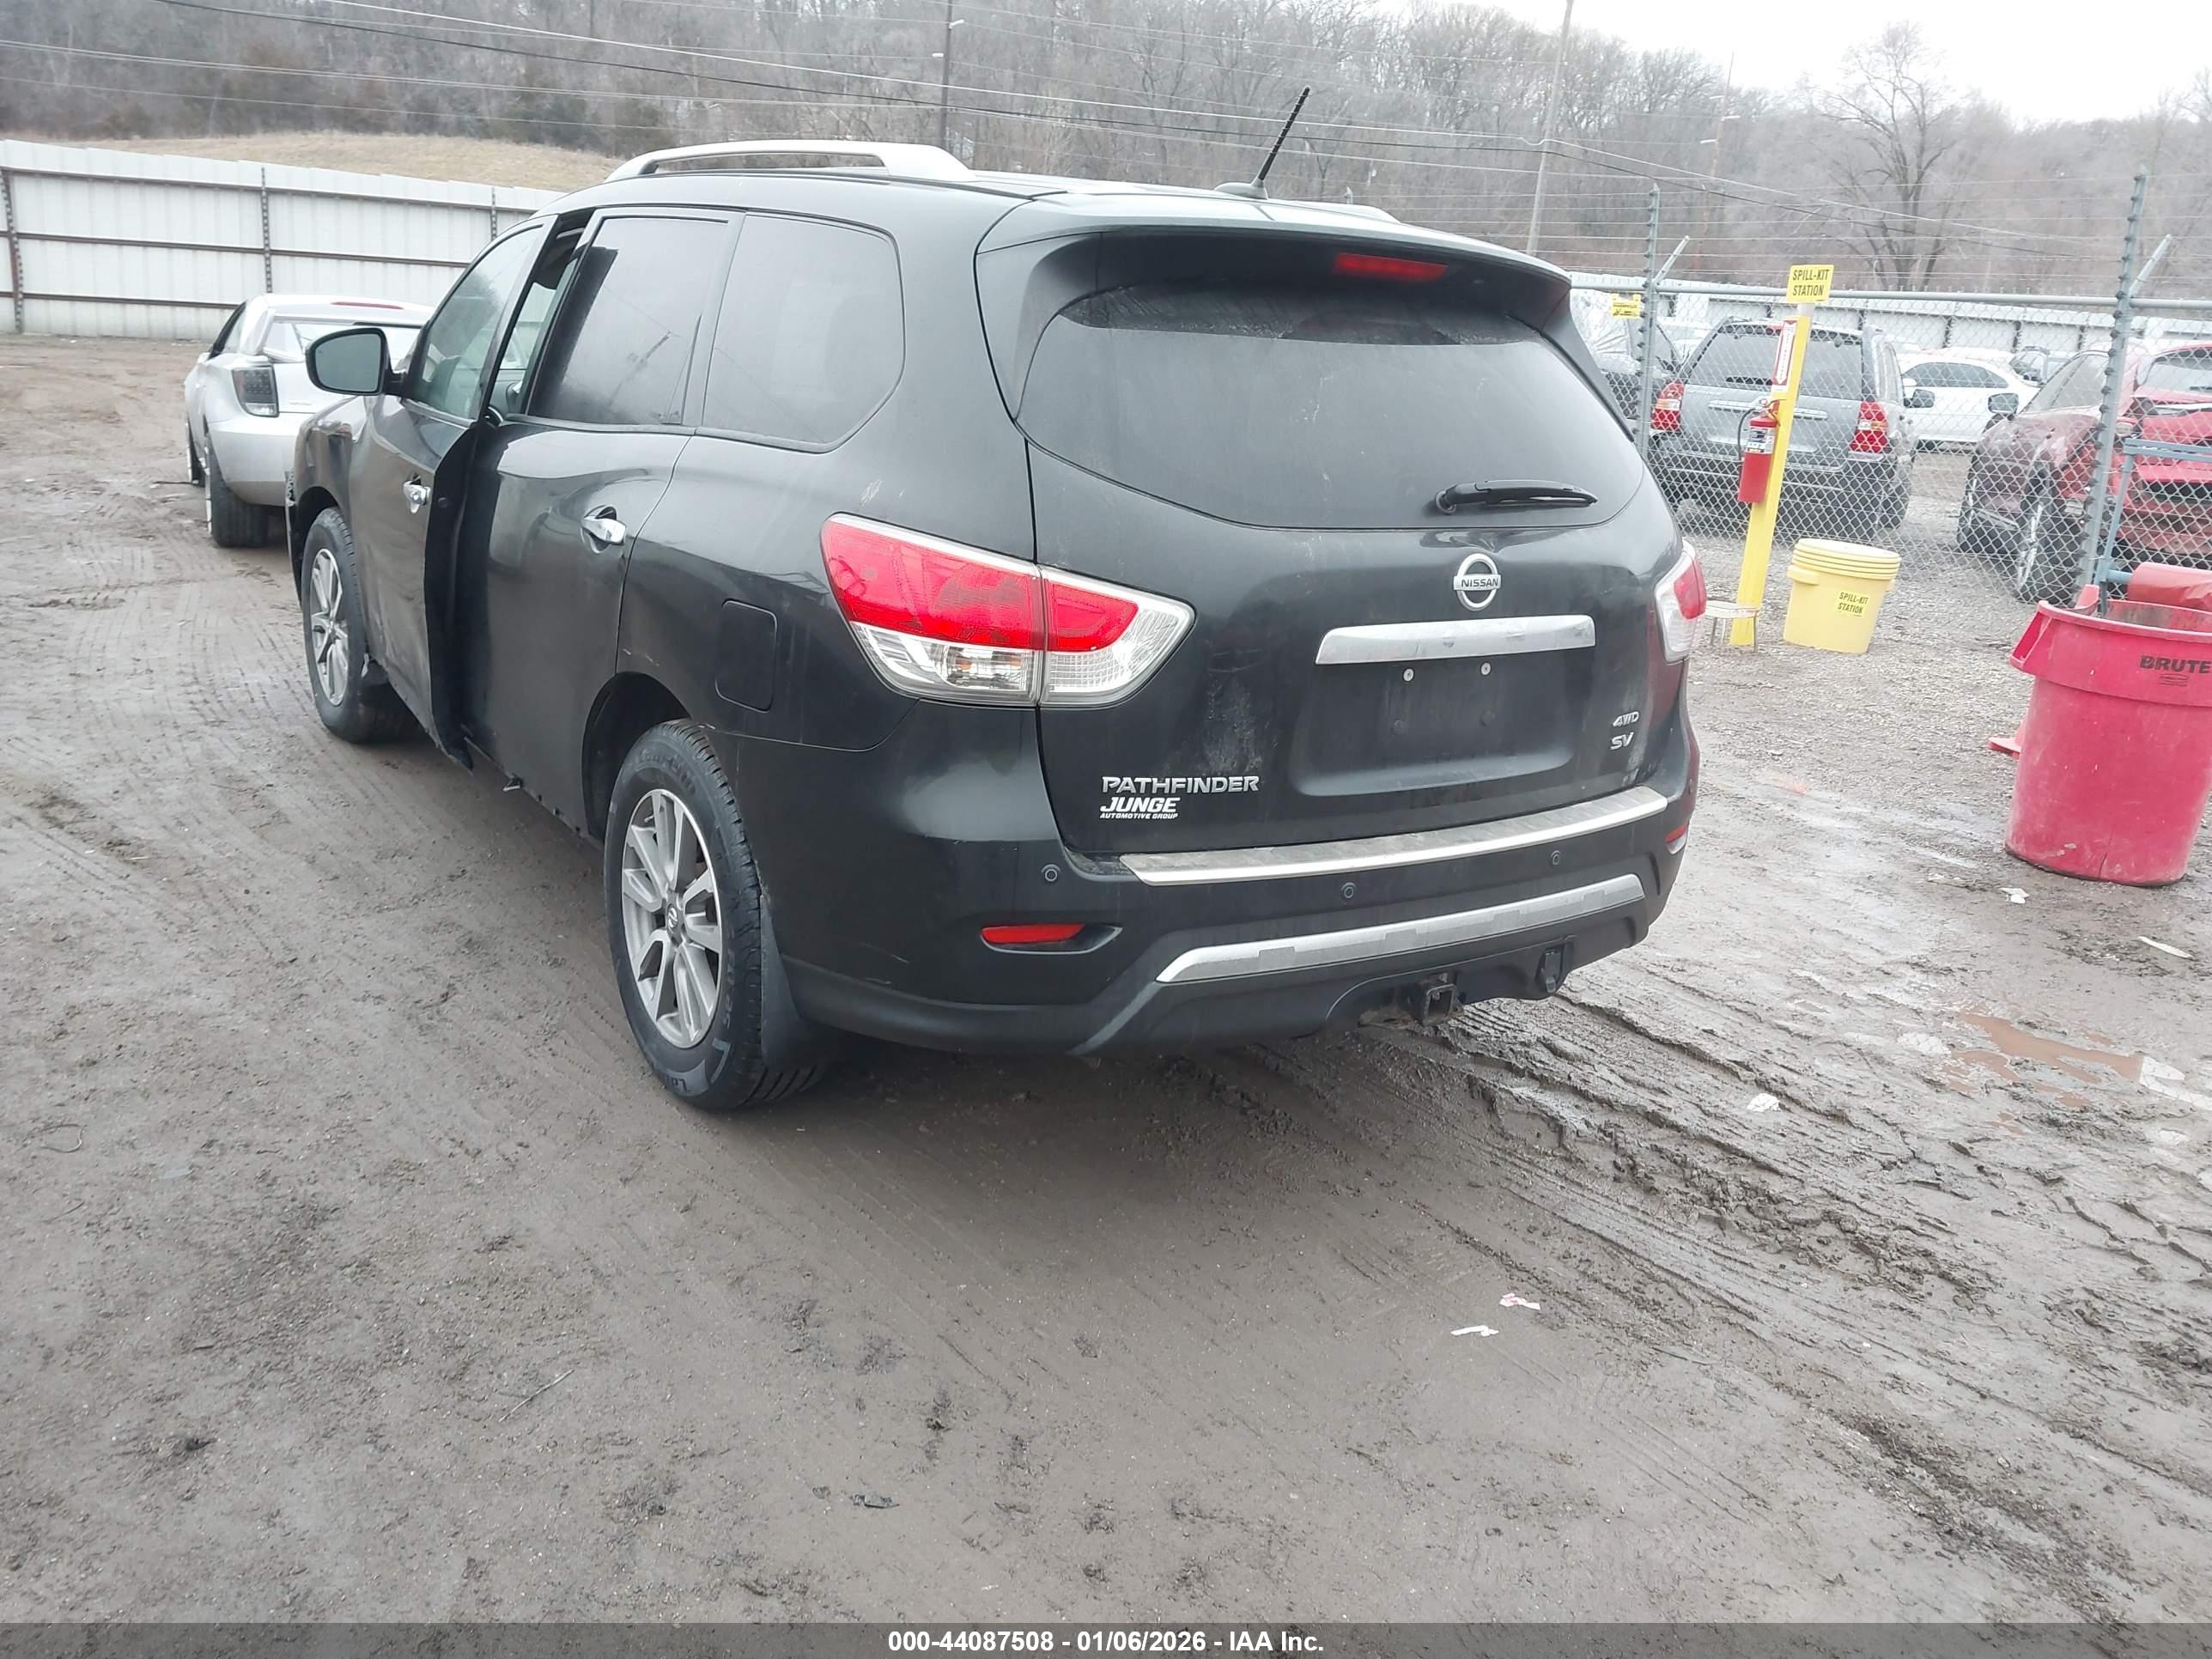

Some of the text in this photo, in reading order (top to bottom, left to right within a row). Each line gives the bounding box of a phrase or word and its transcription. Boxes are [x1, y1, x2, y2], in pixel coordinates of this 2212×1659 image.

[1792, 269, 1830, 281] SPILL-KIT
[1792, 285, 1824, 296] STATION
[1461, 578, 1498, 587] NISSAN
[1838, 592, 1869, 605] SPILL-KIT
[1838, 602, 1863, 614] STATION
[2139, 654, 2212, 674] BRUTE
[1613, 711, 1639, 727] 4WD
[1610, 732, 1634, 750] SV
[1102, 775, 1259, 793] PATHFINDER
[1100, 797, 1181, 812] JUNGE
